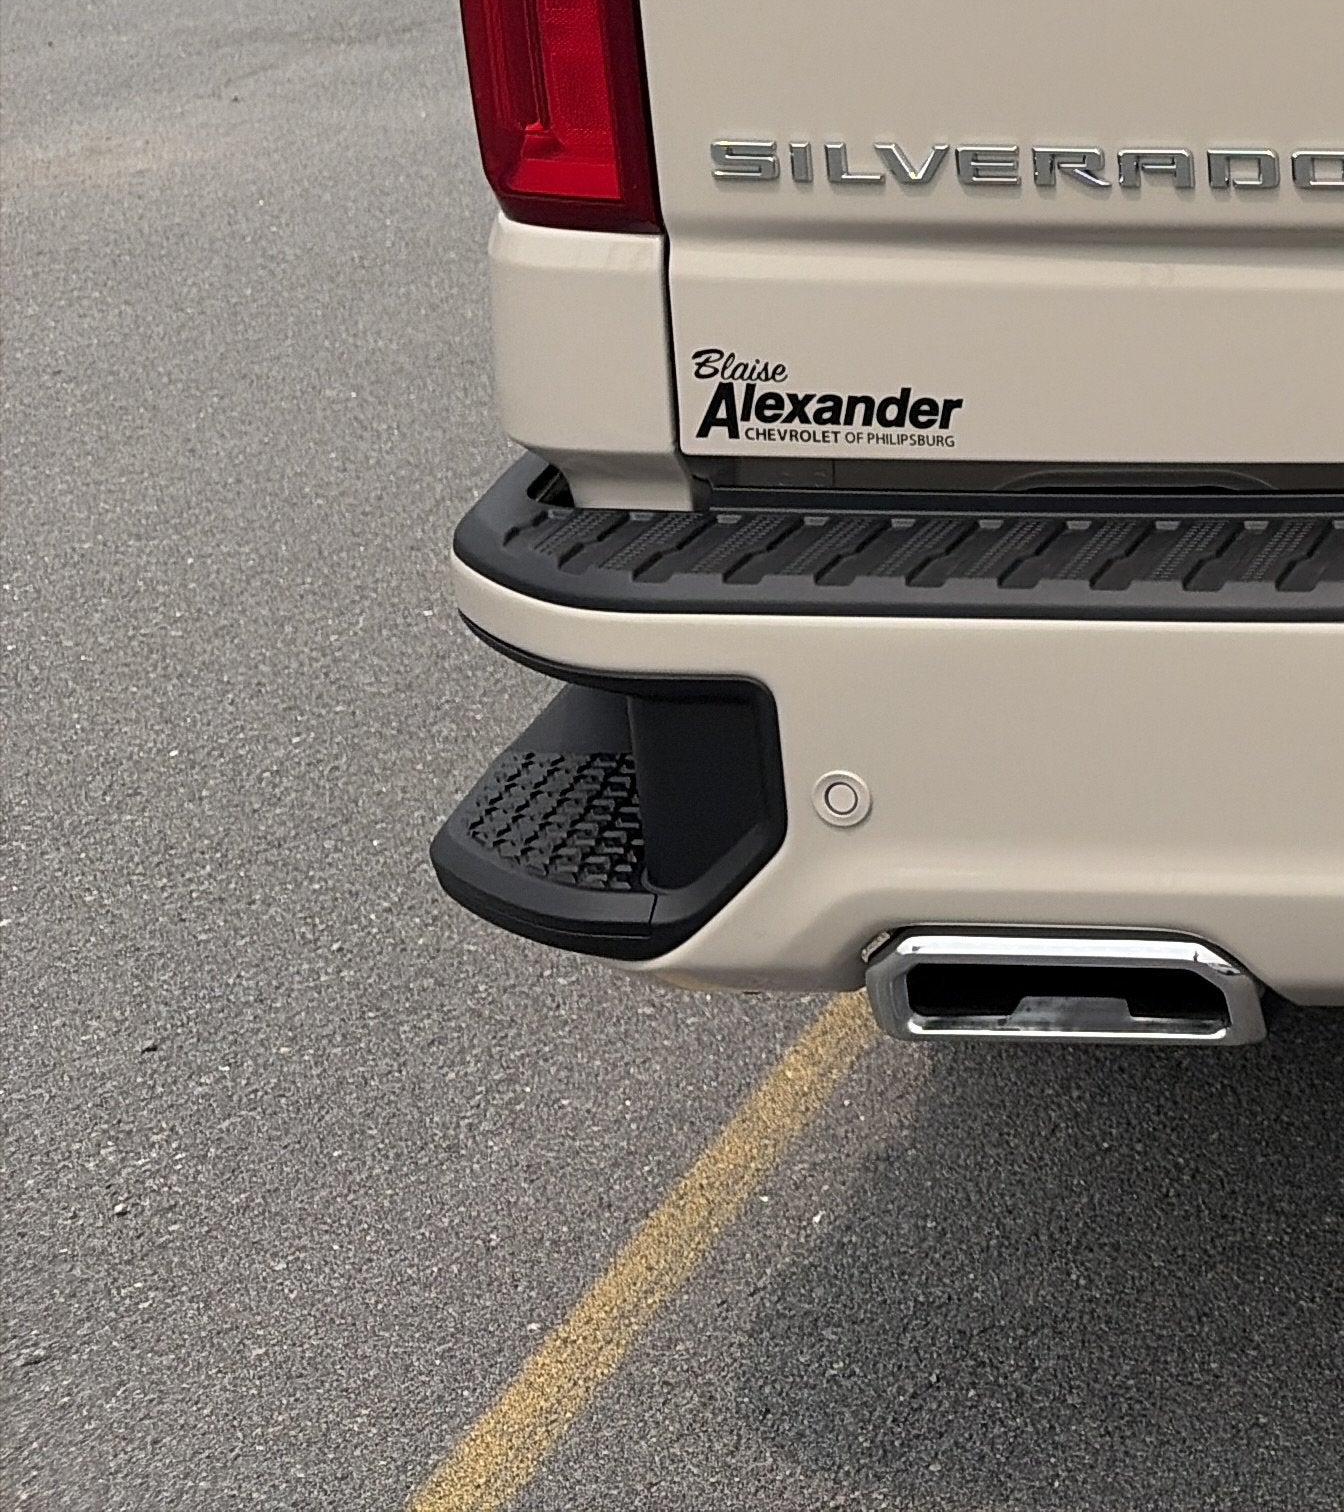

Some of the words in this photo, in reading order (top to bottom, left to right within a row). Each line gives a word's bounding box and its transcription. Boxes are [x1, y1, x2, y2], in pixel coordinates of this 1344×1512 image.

[691, 348, 789, 383] Blaise
[695, 381, 964, 439] Alexander
[744, 427, 841, 444] CHEVROLET
[844, 431, 864, 445] OF
[866, 432, 956, 448] PHILIPSBURG
